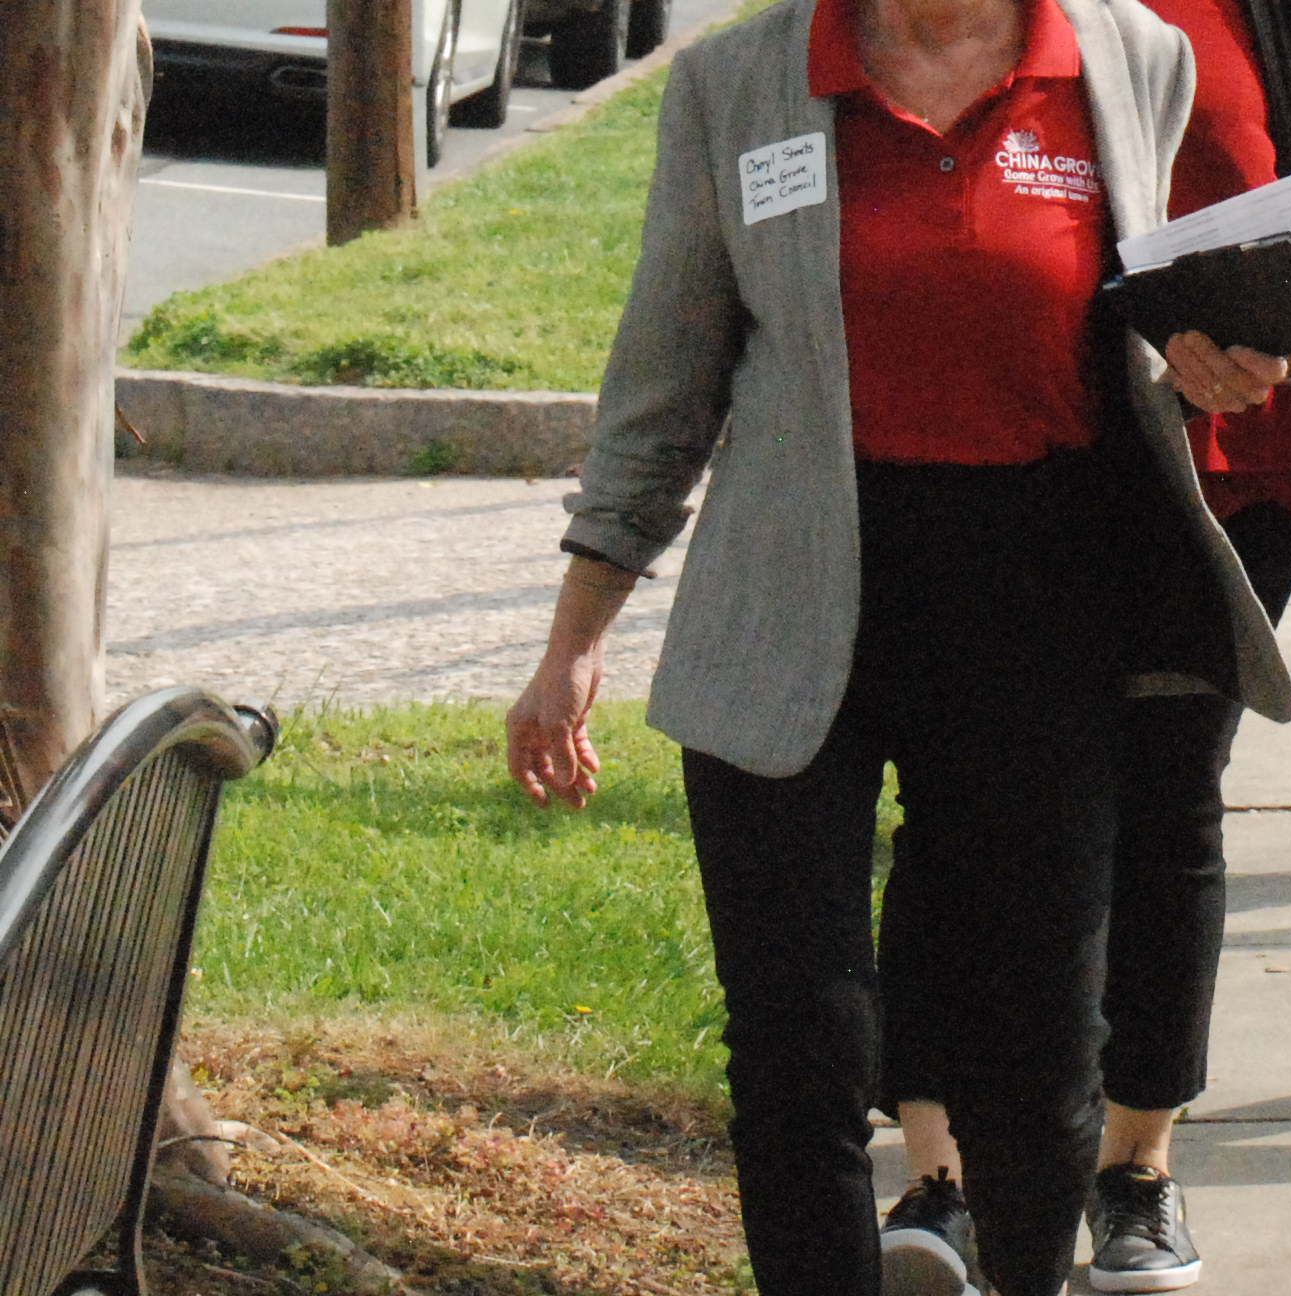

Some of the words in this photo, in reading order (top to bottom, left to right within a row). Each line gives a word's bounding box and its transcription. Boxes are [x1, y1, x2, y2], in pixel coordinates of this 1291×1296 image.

[995, 150, 1053, 171] CHINA
[1053, 156, 1096, 177] GROV
[1003, 168, 1036, 182] Come
[1037, 170, 1065, 183] Grow
[1014, 184, 1030, 195] An
